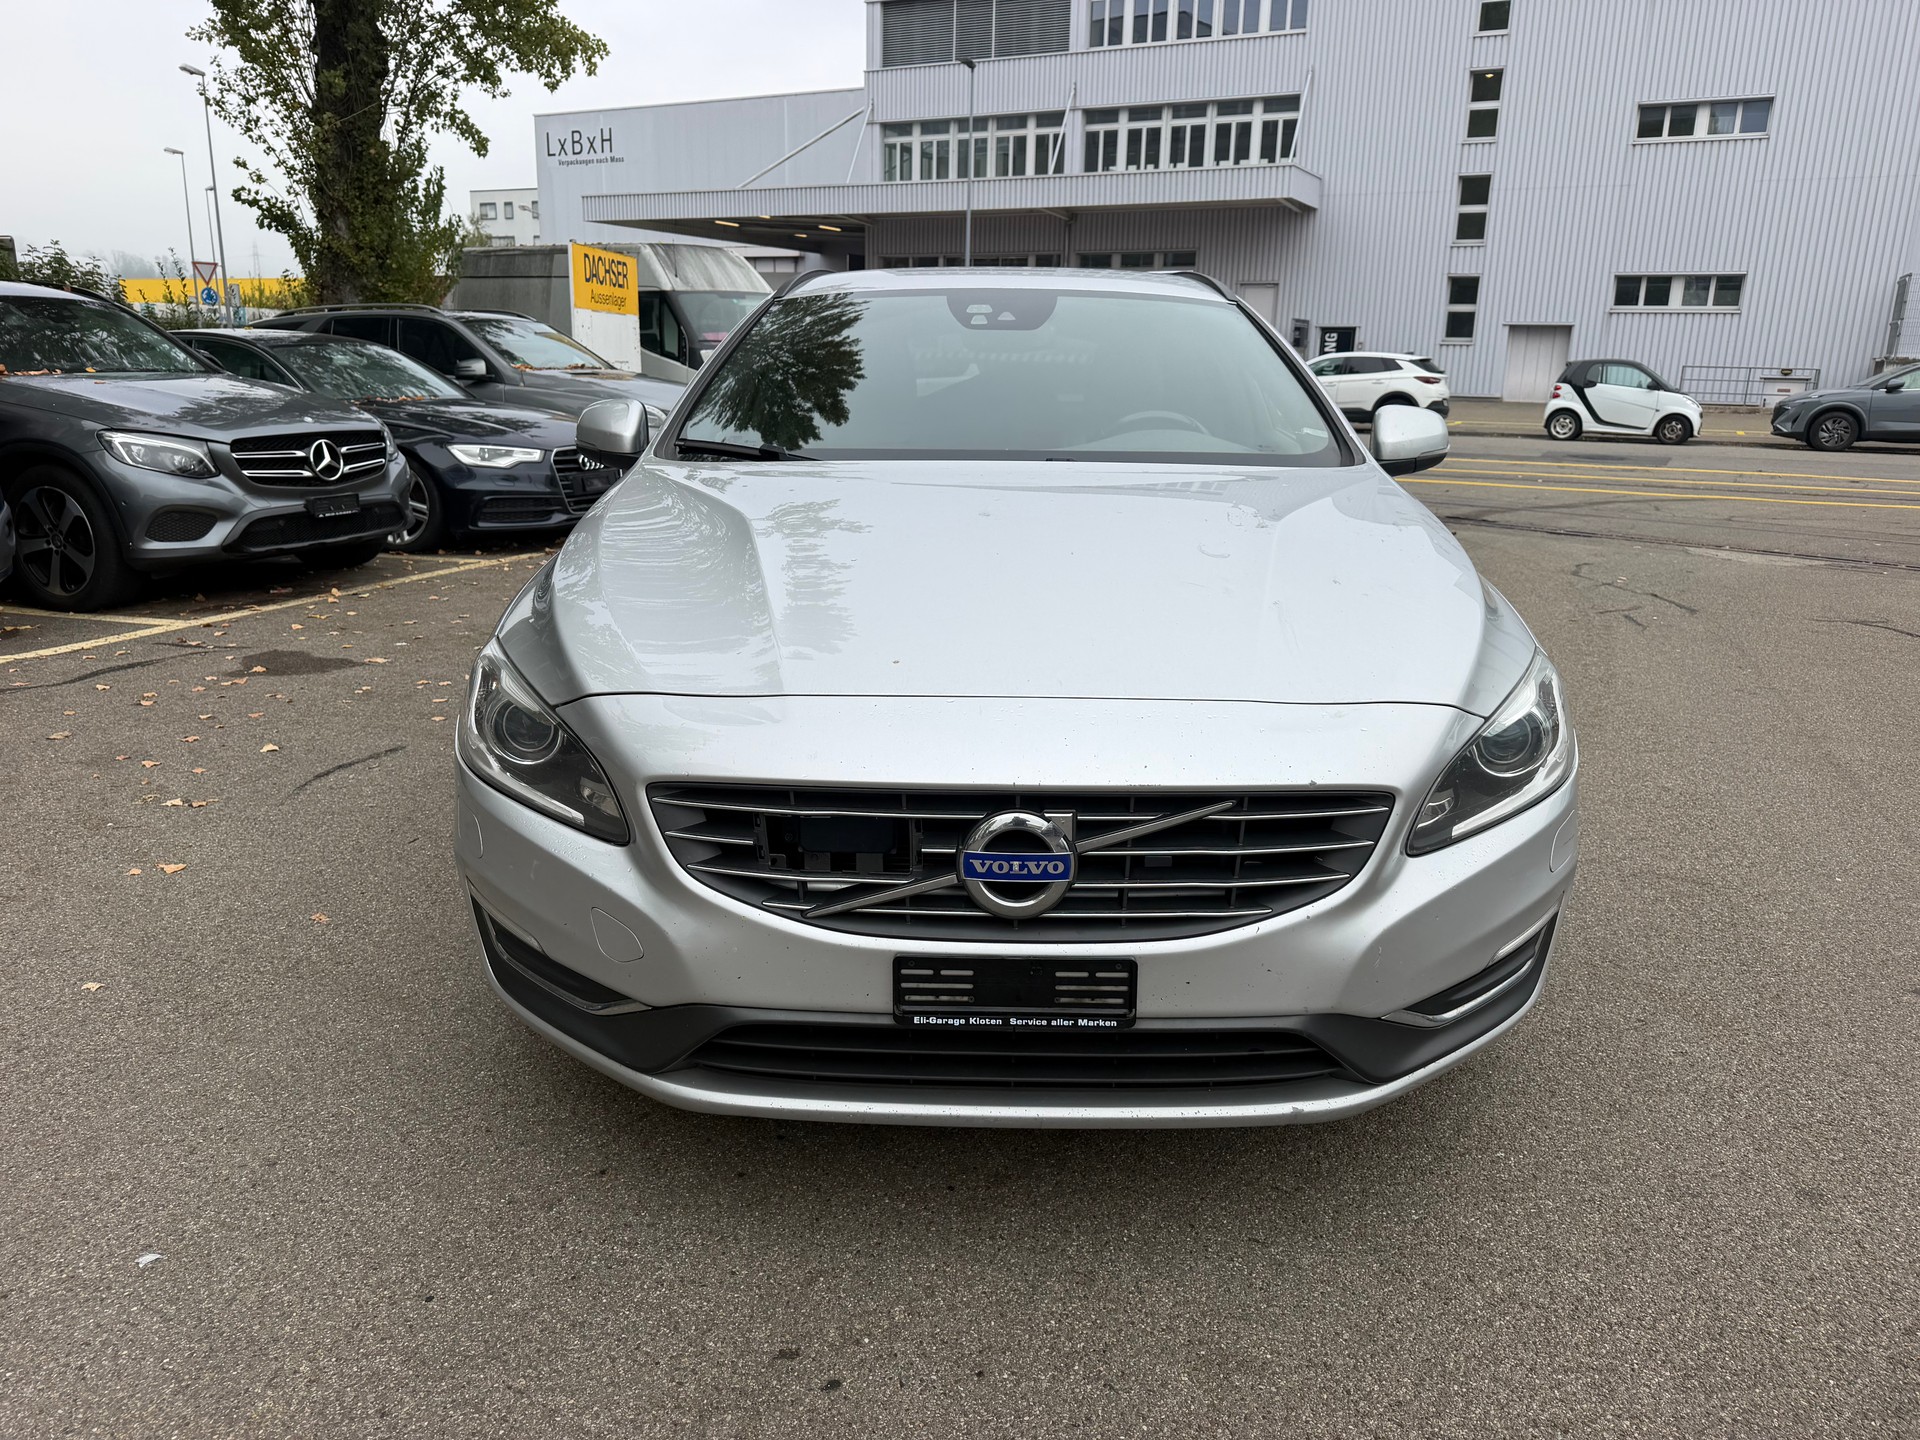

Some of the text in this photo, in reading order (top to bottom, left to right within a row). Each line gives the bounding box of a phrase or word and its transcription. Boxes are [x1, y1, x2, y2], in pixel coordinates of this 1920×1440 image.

[558, 155, 624, 167] Verpackungen nach Mass
[583, 252, 629, 290] DACHSER
[590, 288, 627, 311] Aussenlager
[1324, 332, 1338, 353] NG
[969, 859, 1065, 875] VOLVO
[913, 1016, 1117, 1027] Eli-Garage Kloten Service aller Marken
